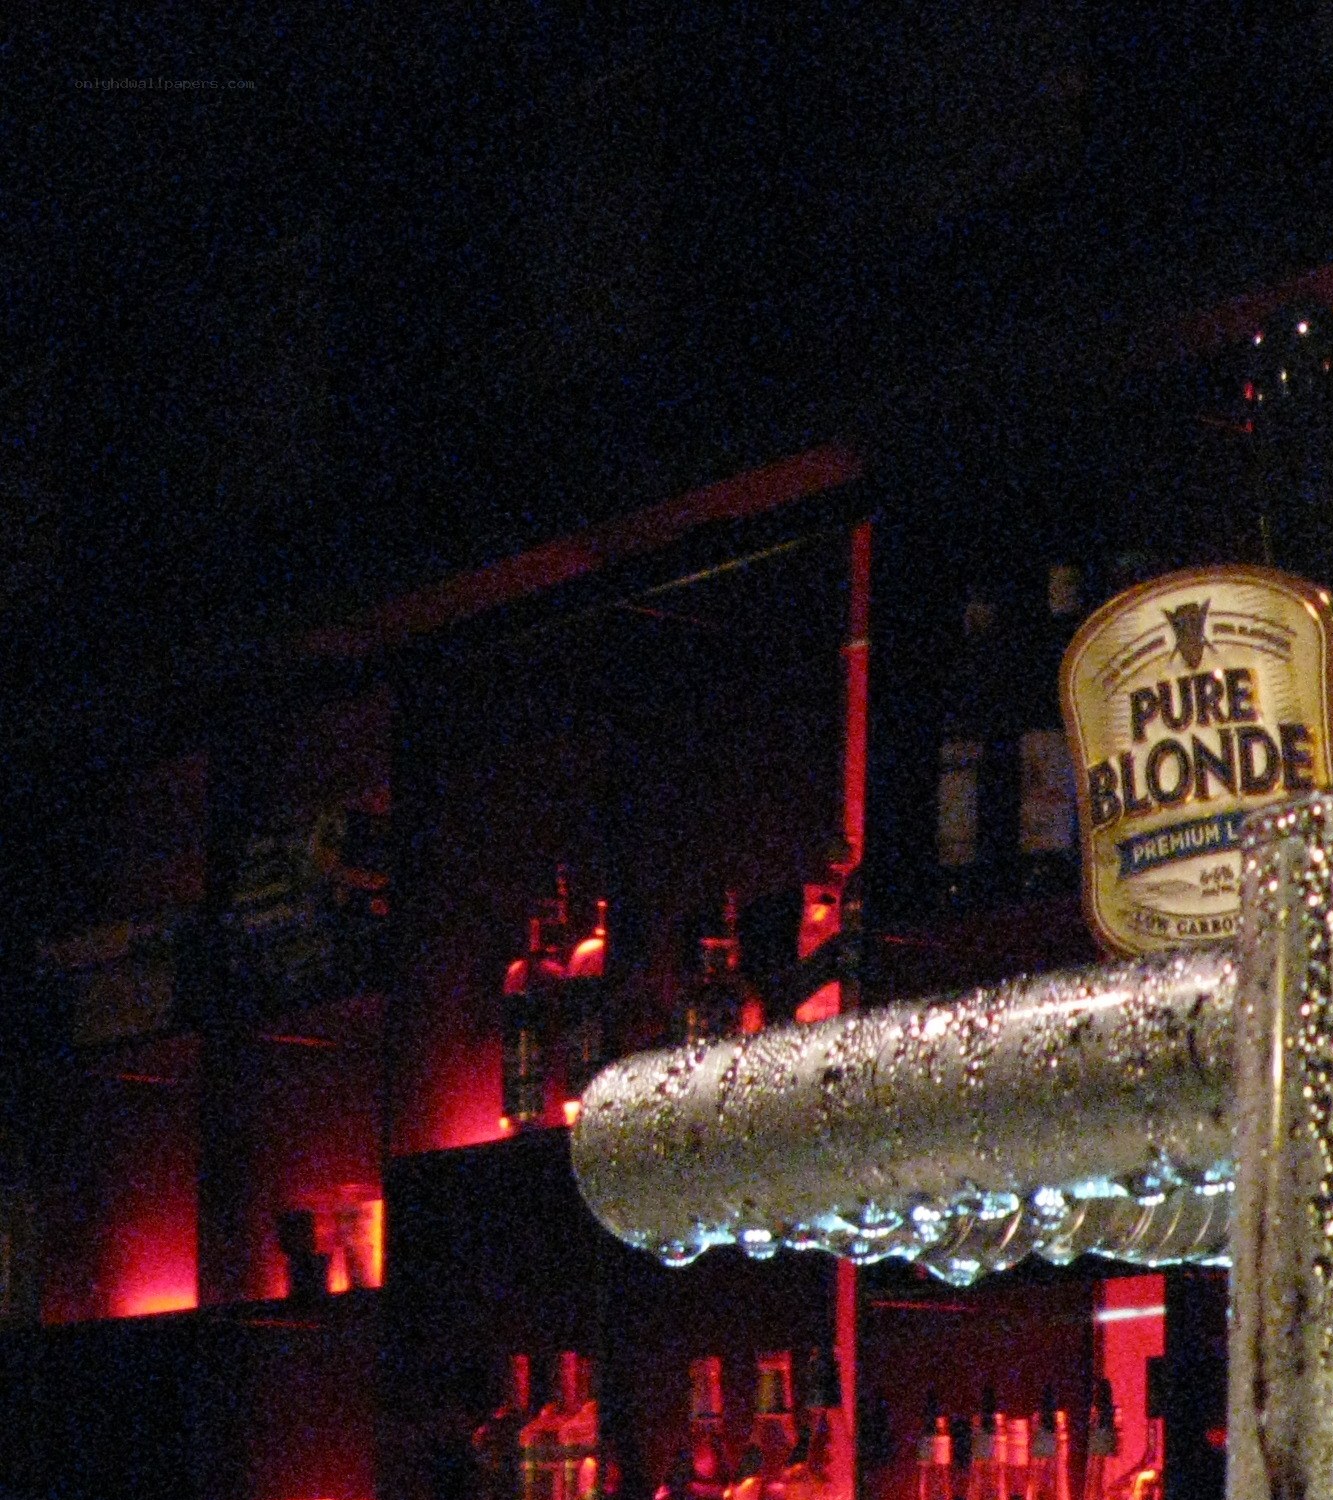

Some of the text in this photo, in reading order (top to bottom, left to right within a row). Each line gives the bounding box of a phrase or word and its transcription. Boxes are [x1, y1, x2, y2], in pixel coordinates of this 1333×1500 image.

[1130, 667, 1258, 744] PURE
[1088, 722, 1317, 826] BLONDE
[1132, 822, 1220, 865] PREMIUM
[1176, 914, 1236, 935] CARBO
